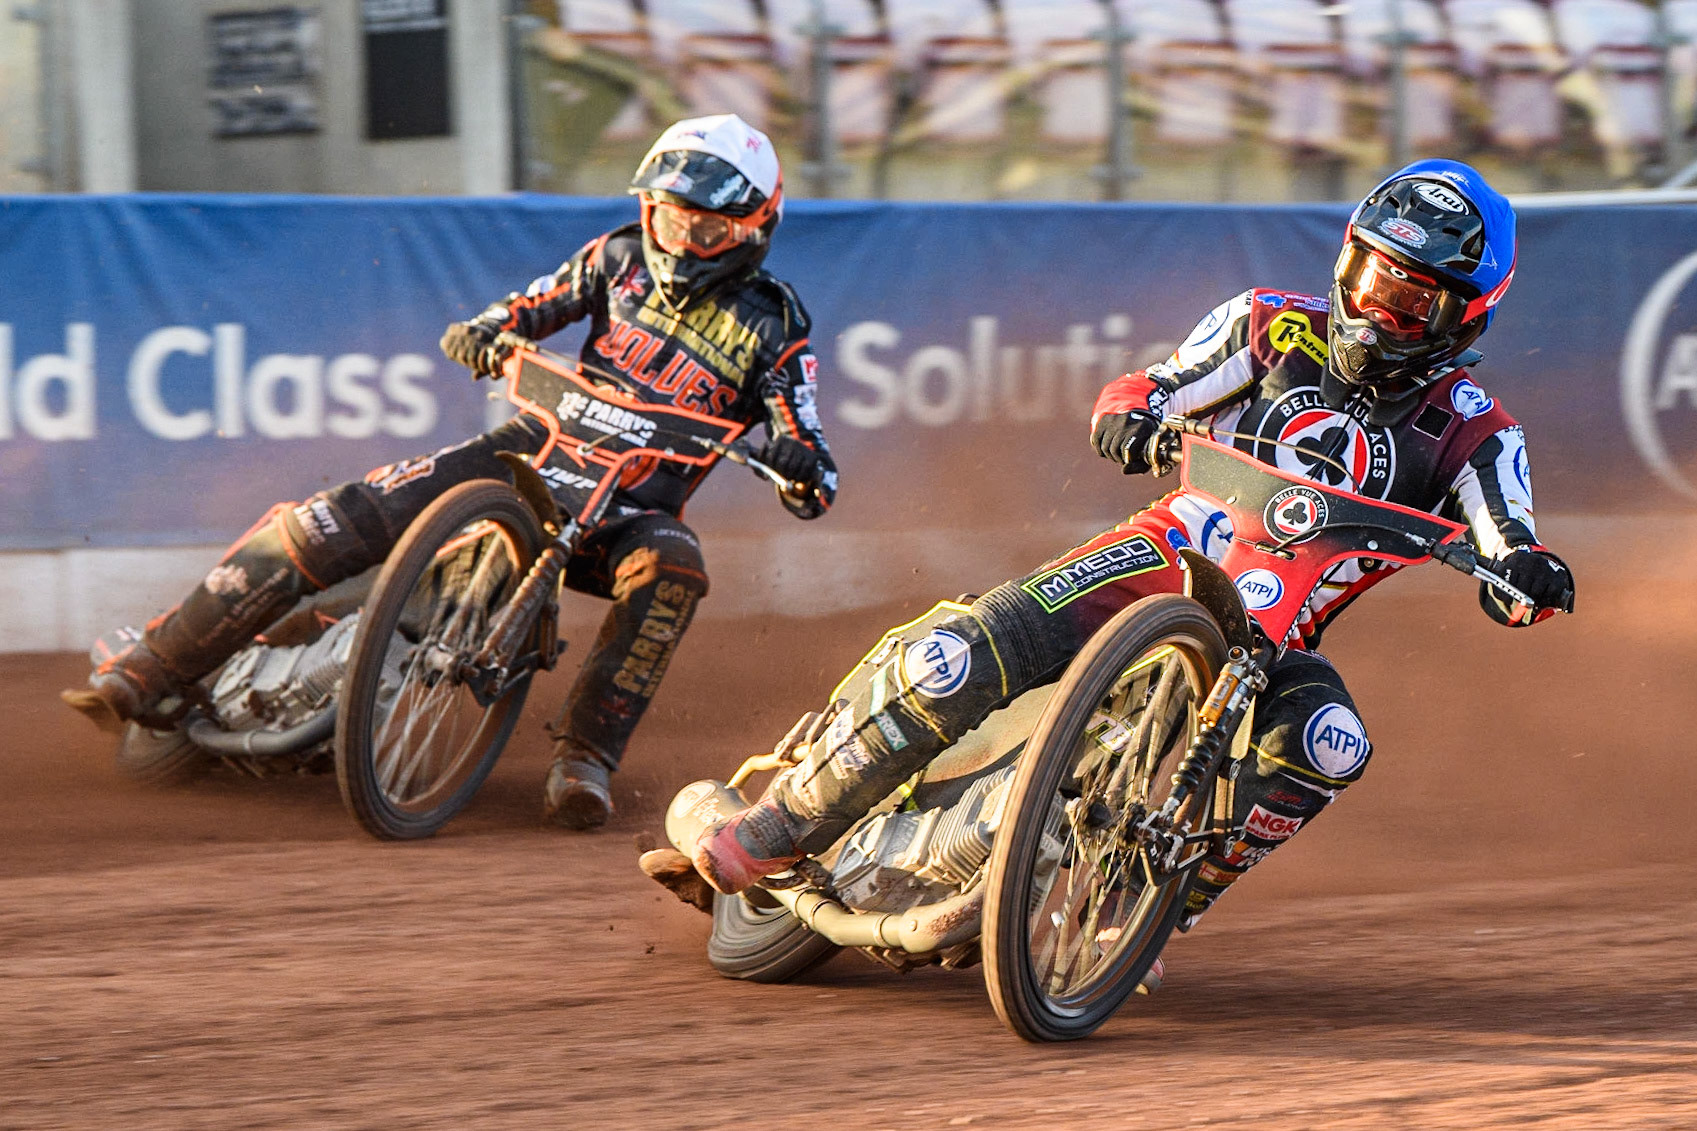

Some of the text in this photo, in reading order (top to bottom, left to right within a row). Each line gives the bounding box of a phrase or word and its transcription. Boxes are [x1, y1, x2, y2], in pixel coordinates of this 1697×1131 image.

[1424, 185, 1463, 210] Arai
[1385, 221, 1422, 242] STS
[127, 322, 441, 442] Class
[585, 399, 658, 440] PARRYS
[1369, 432, 1388, 481] ACES
[537, 465, 599, 489] JWP
[1274, 488, 1326, 518] BELLE VUE ACES
[1074, 553, 1159, 589] CONSTRUCTION
[1240, 580, 1274, 599] ATPI
[602, 580, 685, 695] PARRYS
[923, 640, 953, 685] ATPI
[1315, 724, 1362, 759] ATPI
[1248, 808, 1300, 834] NGK
